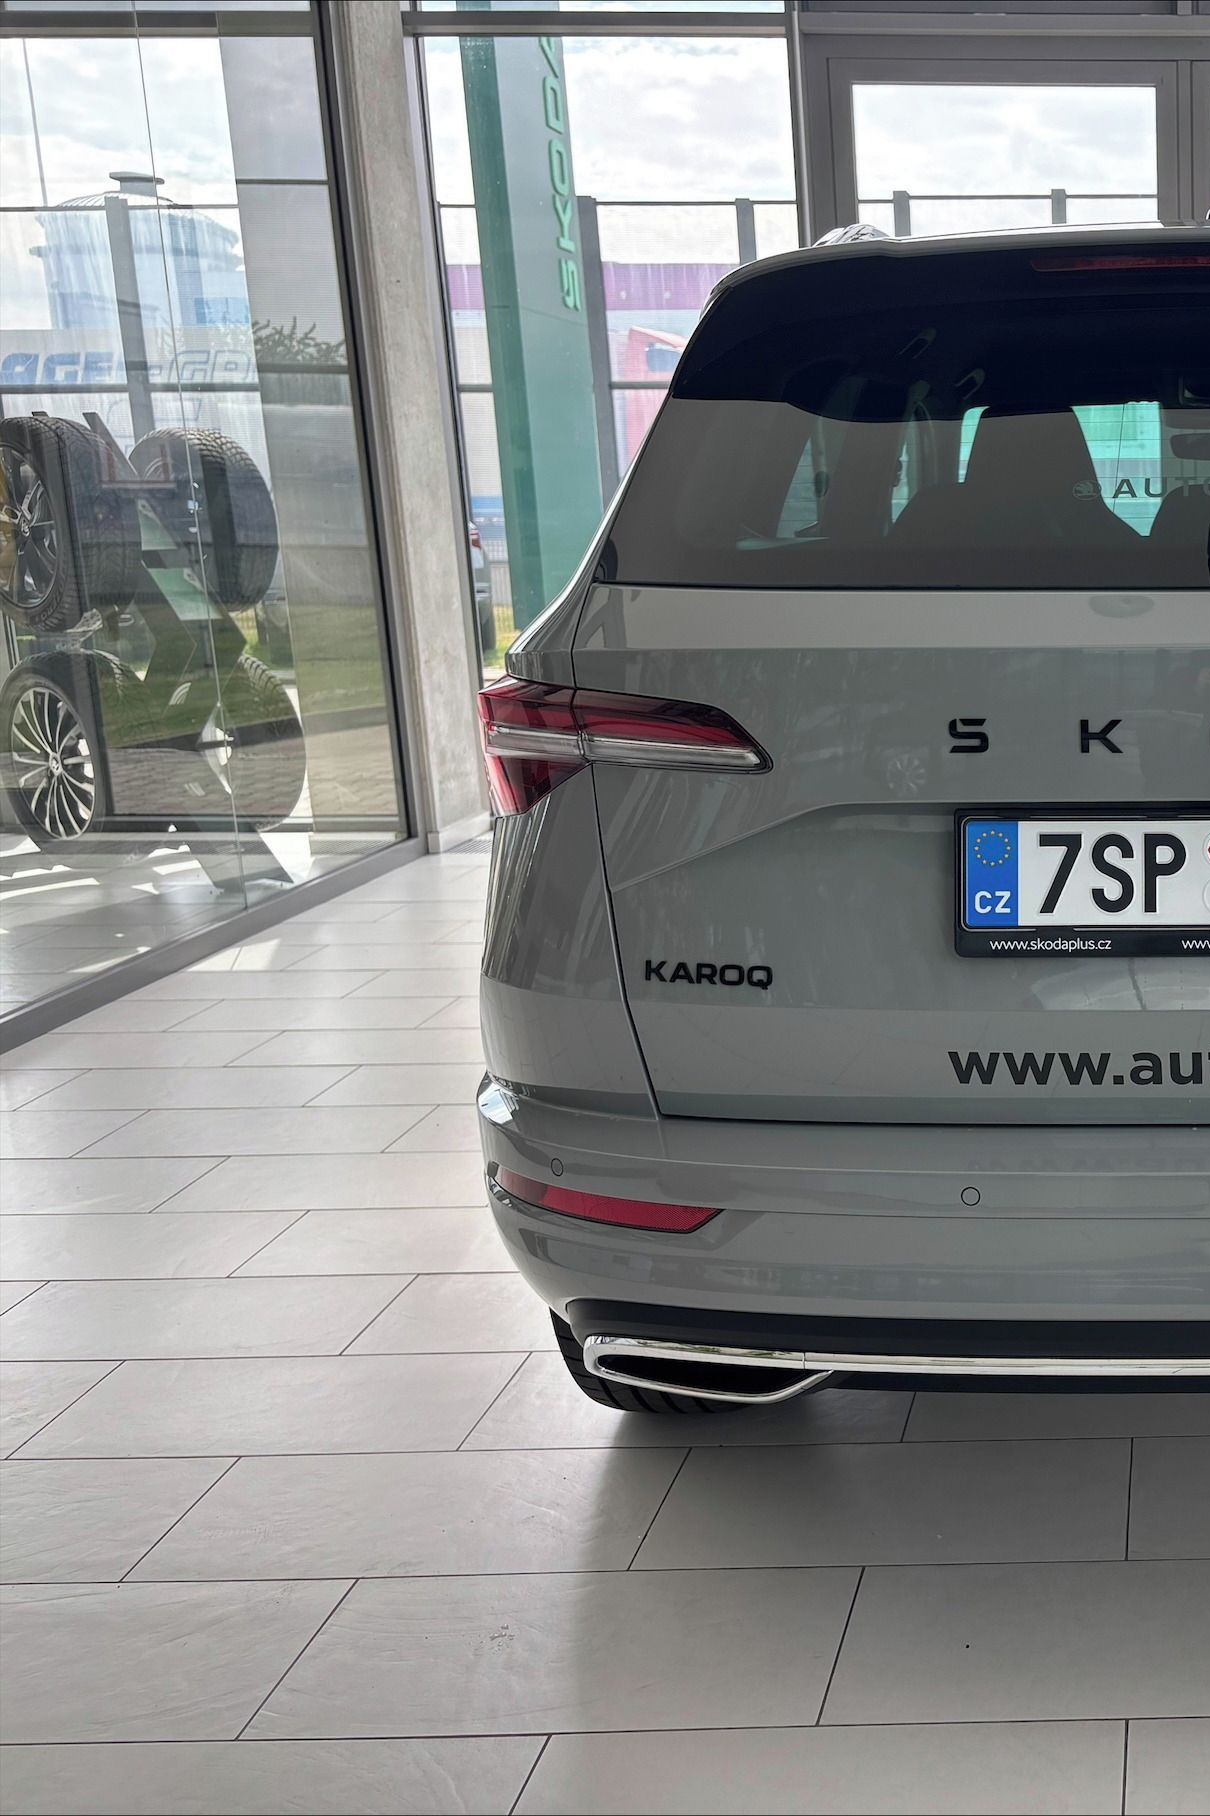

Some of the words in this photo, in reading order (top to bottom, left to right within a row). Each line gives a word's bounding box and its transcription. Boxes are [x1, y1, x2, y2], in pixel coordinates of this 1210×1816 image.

[1038, 833, 1187, 914] 7SP
[974, 890, 1011, 915] CZ
[989, 937, 1112, 952] www.skodaplus.cz
[645, 959, 773, 990] KAROQ
